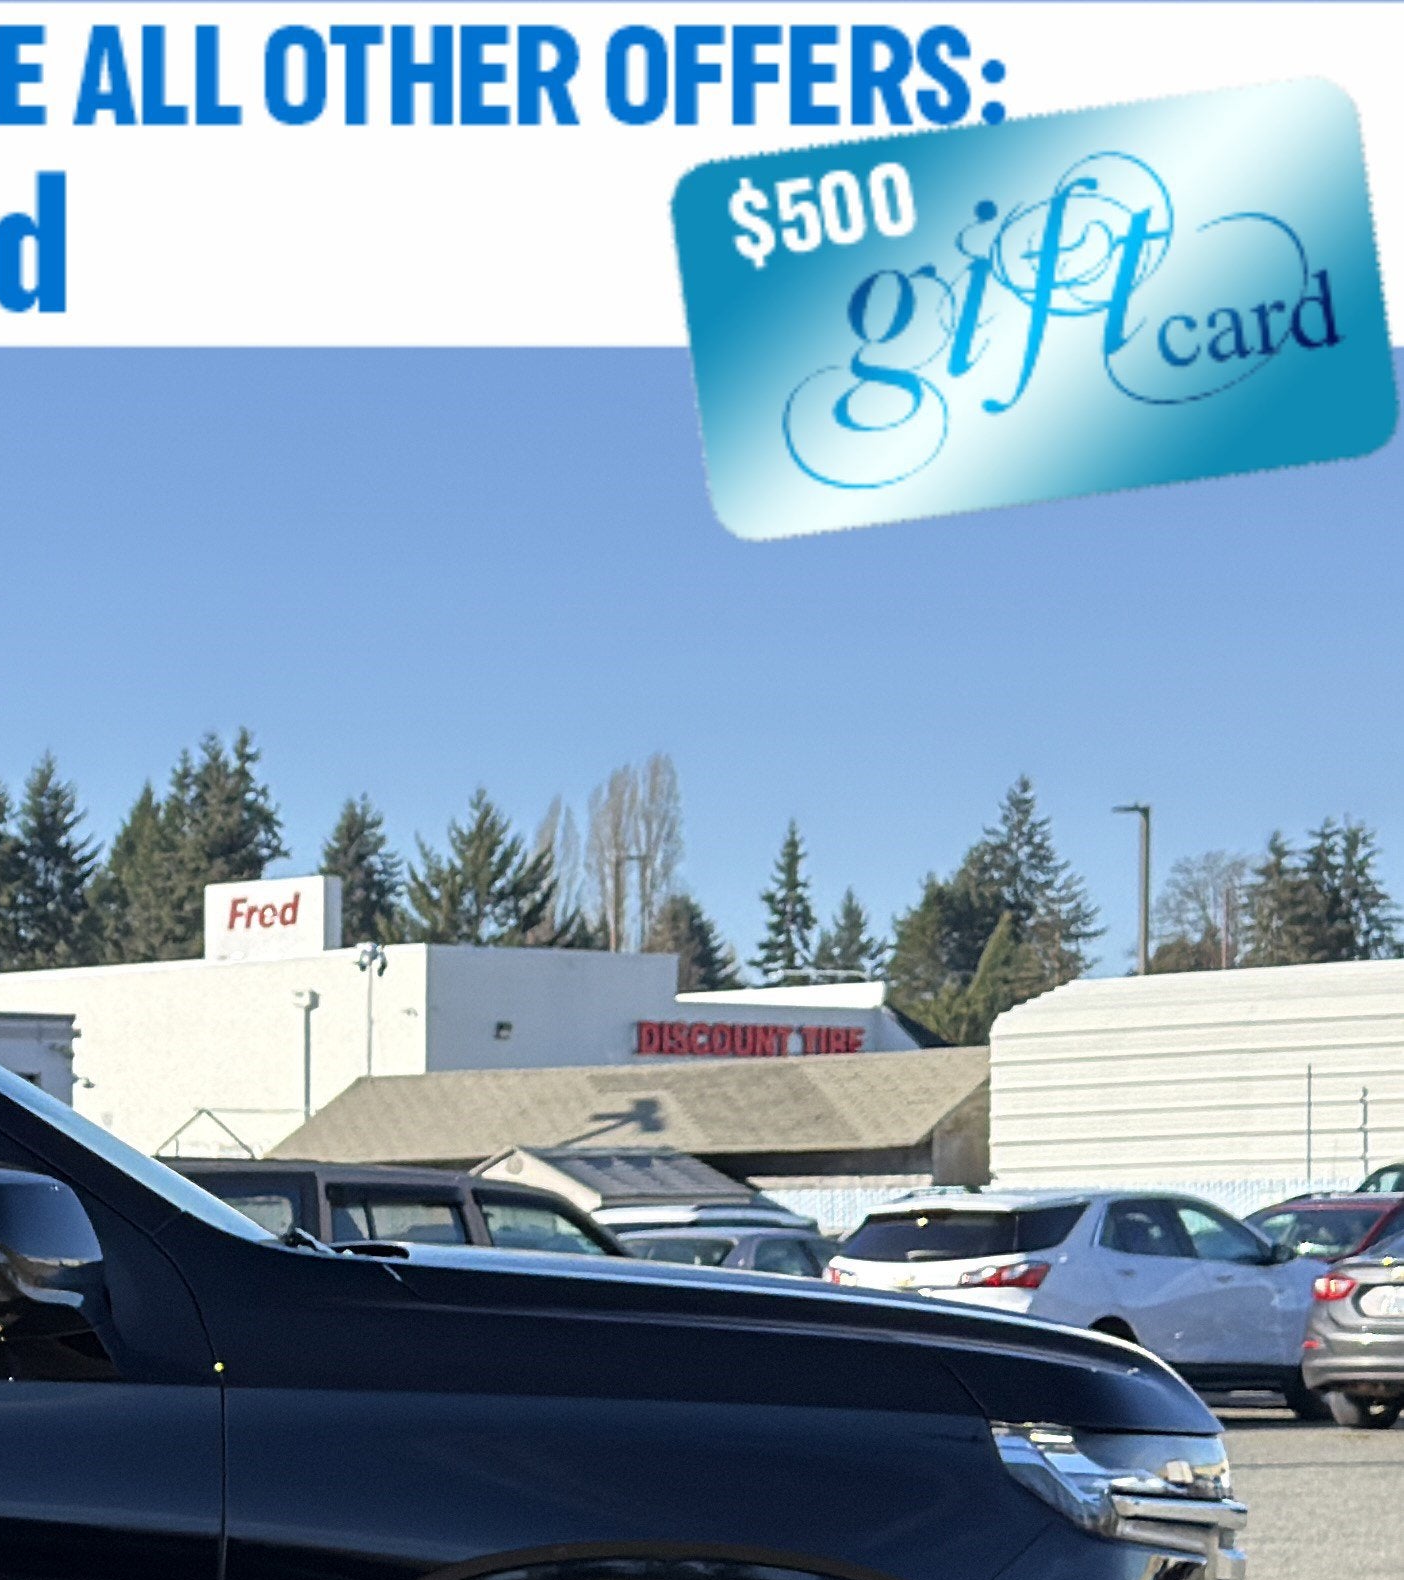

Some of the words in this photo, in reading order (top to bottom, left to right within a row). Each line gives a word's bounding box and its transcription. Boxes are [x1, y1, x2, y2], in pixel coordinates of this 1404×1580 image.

[227, 890, 301, 930] Fred
[636, 1020, 794, 1056] DISCOUNT
[801, 1026, 866, 1054] TIRE
